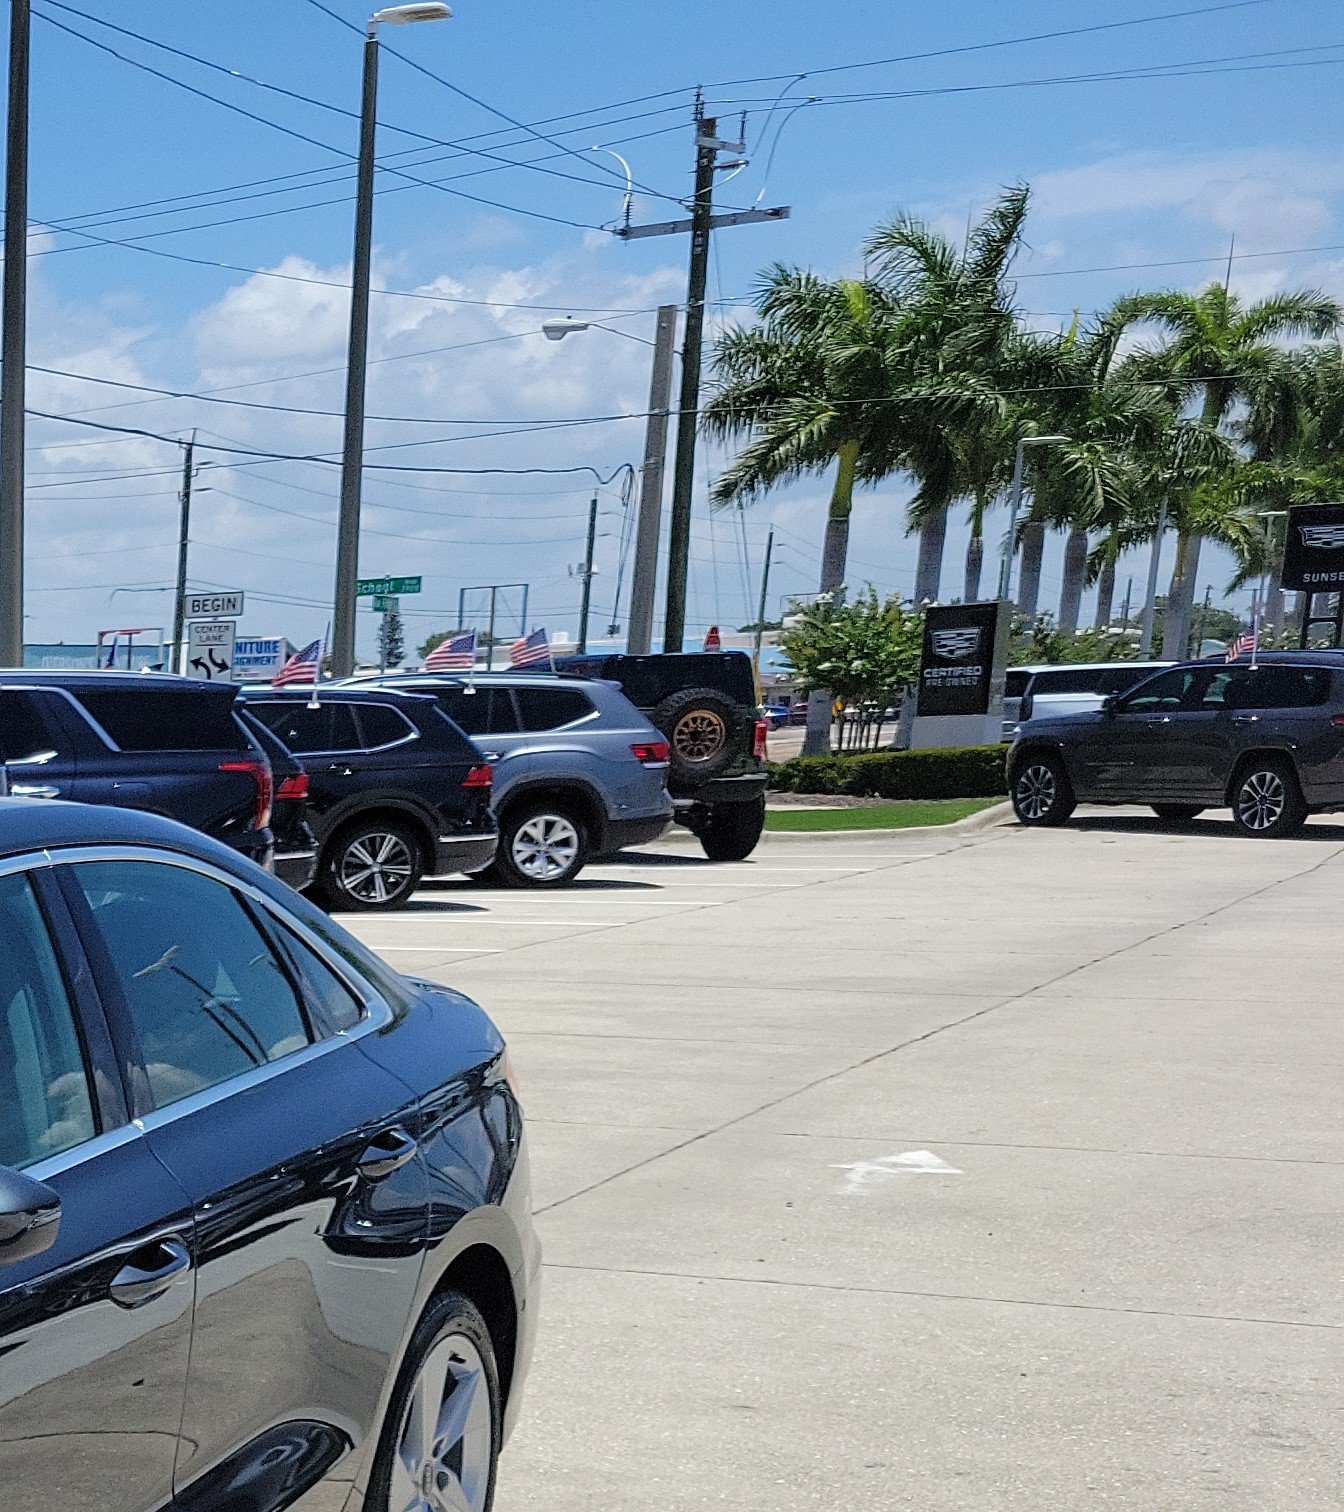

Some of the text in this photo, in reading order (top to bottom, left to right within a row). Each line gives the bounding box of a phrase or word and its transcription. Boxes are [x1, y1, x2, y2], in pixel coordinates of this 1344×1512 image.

[1303, 572, 1344, 582] SUNSE
[192, 597, 237, 613] BEGIN
[194, 625, 230, 634] CENTER
[199, 634, 225, 643] LANE
[235, 640, 280, 654] NITURE
[924, 666, 982, 677] CERTIFIED
